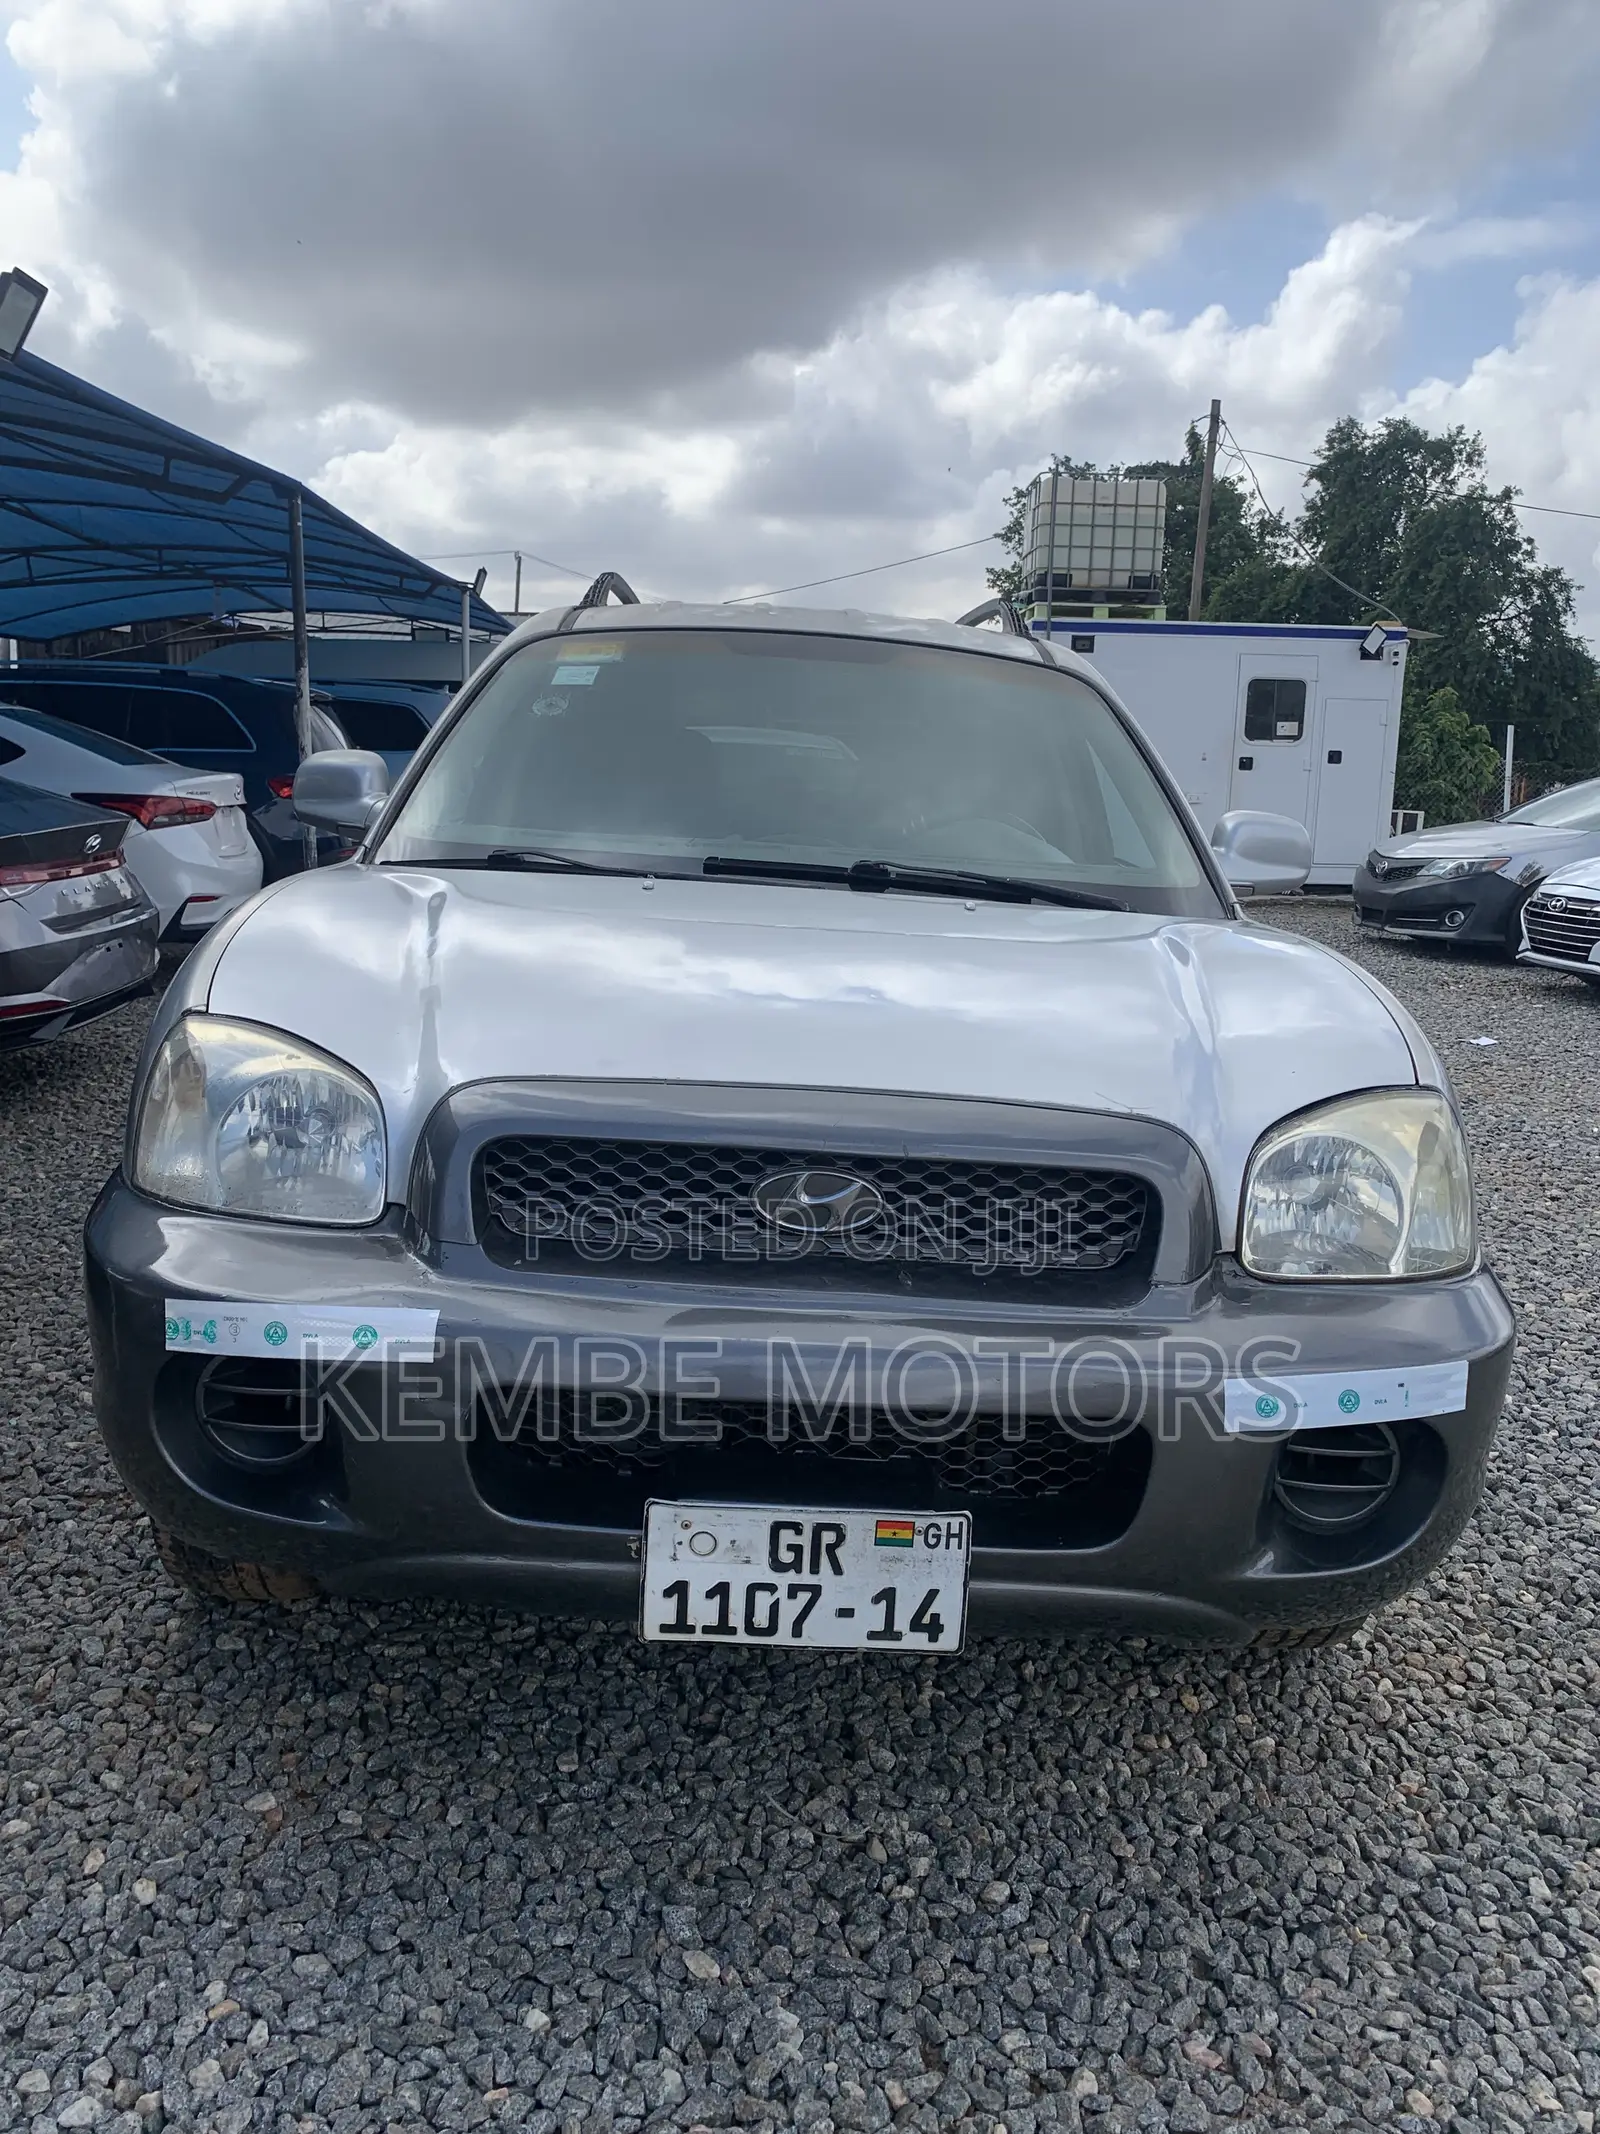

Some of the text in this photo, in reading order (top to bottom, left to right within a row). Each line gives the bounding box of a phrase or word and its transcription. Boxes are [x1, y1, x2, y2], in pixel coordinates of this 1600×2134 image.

[768, 1520, 963, 1576] GR GH
[659, 1580, 945, 1643] 1107-14
